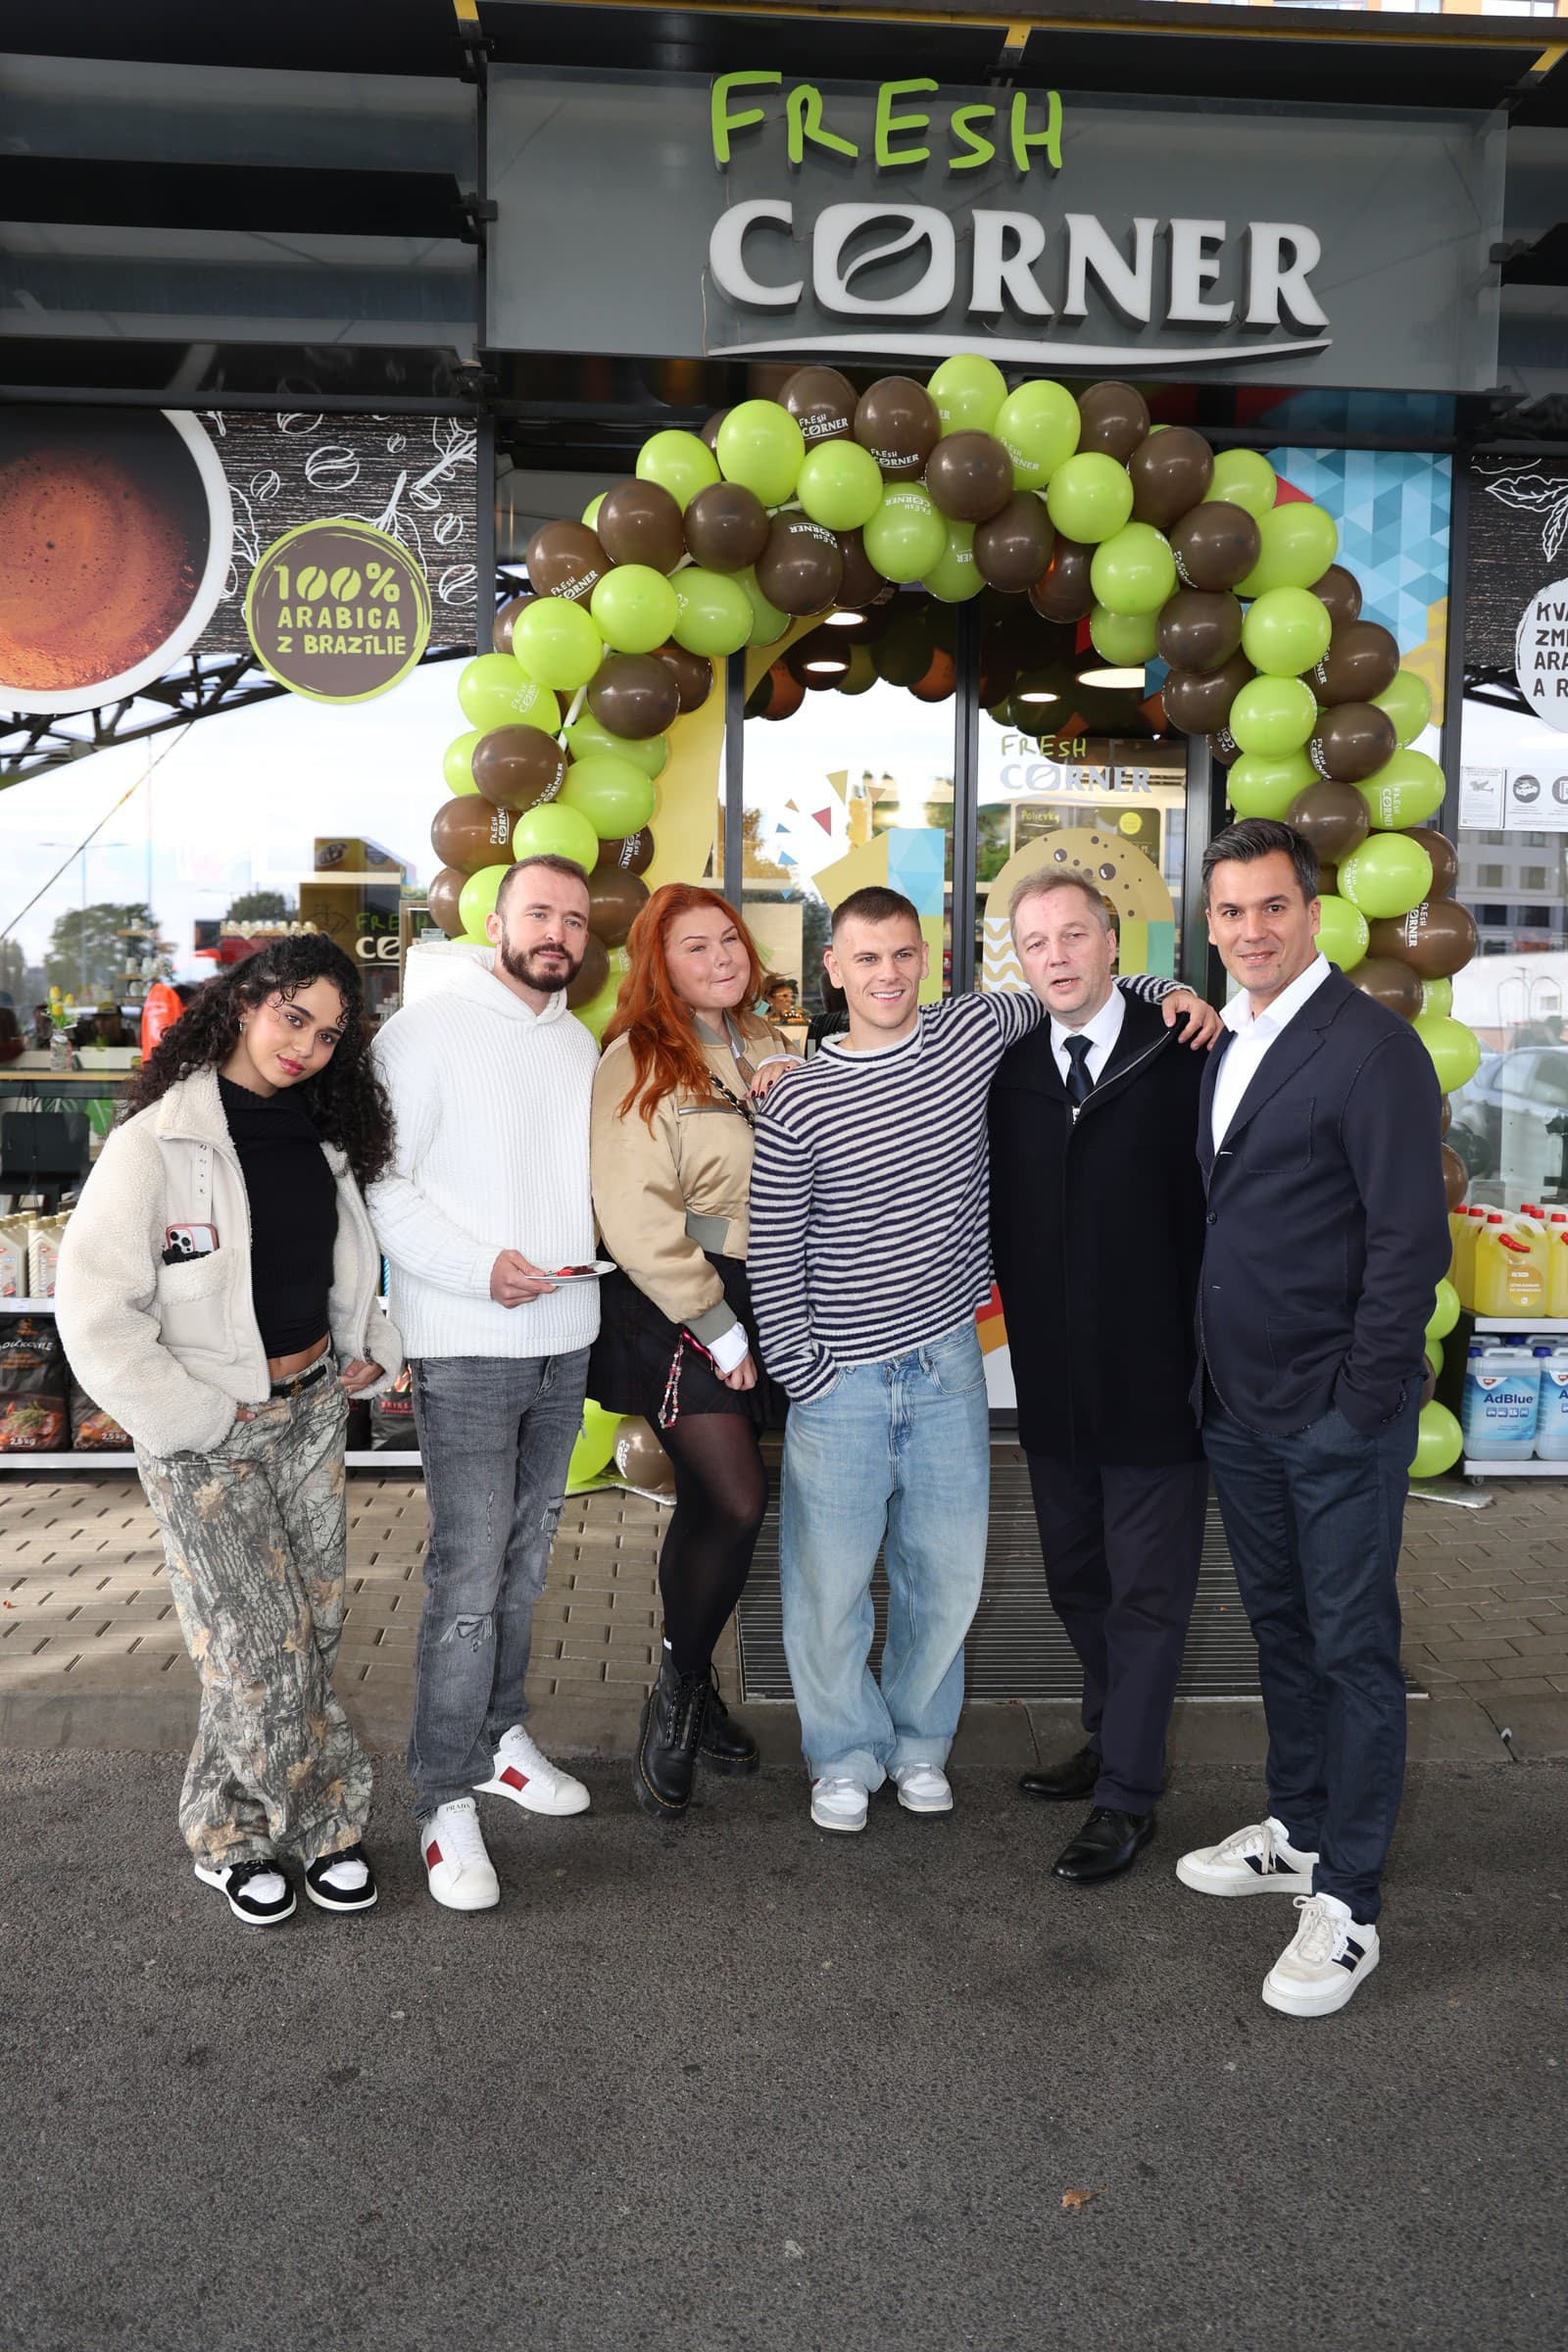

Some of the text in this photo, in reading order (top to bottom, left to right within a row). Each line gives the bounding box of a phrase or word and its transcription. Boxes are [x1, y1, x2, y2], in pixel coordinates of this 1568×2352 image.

[710, 71, 1063, 172] FRESH
[709, 199, 1331, 326] CORNER
[799, 414, 827, 426] FRESH
[802, 417, 849, 437] CORNER
[870, 448, 898, 458] FRESH
[273, 563, 401, 602] 100%
[551, 576, 576, 597] FRESH
[276, 606, 401, 629] ARABICA
[304, 634, 406, 655] BRAZÍLIE
[1533, 678, 1545, 697] A
[1002, 734, 1087, 758] FRESH
[1000, 763, 1152, 793] CORNER
[1407, 907, 1419, 948] ORNER
[1484, 1394, 1534, 1404] AdBlue
